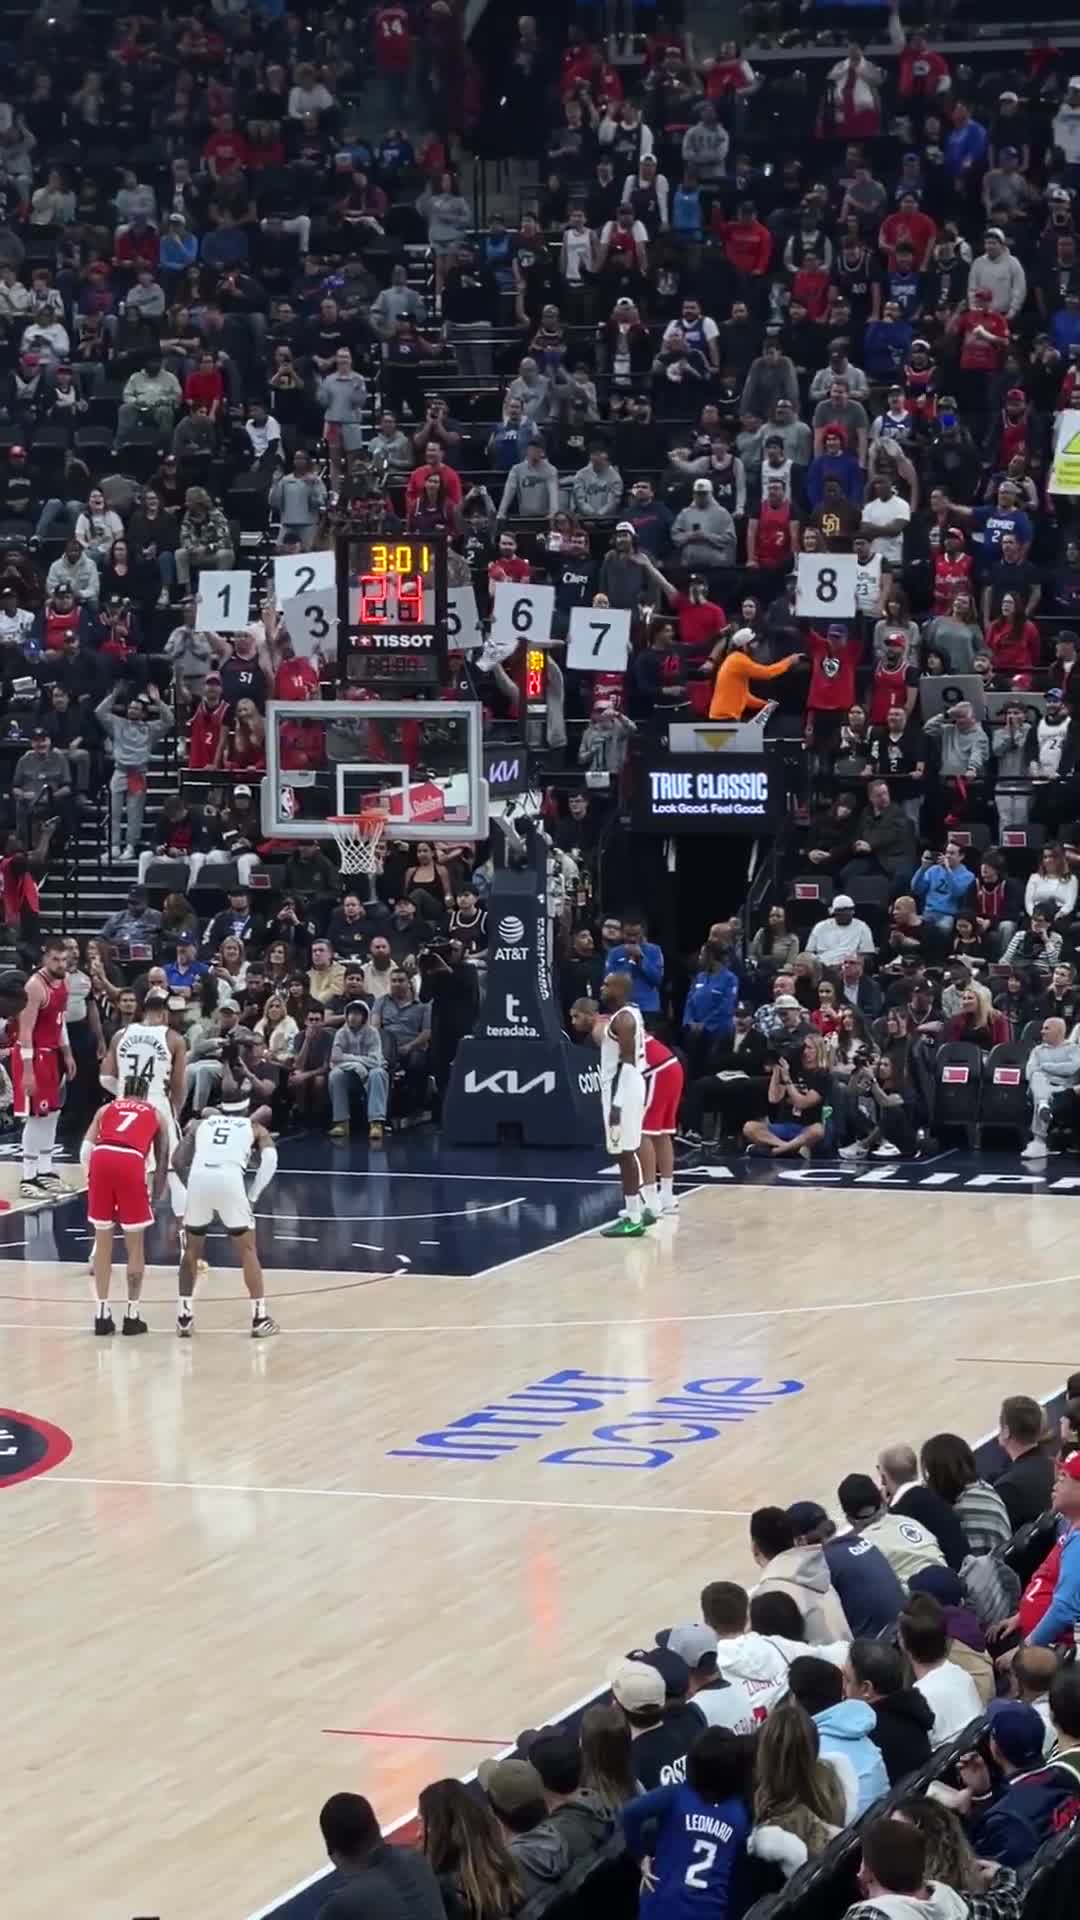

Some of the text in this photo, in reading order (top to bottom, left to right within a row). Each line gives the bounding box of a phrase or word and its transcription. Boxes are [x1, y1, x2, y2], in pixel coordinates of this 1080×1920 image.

[371, 546, 430, 573] 3:01
[295, 566, 316, 597] 2
[816, 567, 838, 603] 8
[217, 584, 232, 618] 1
[361, 575, 423, 623] 24
[304, 605, 330, 638] 3
[448, 602, 462, 636] 5
[511, 598, 534, 632] 6
[589, 622, 612, 656] 7
[649, 772, 768, 800] TRUE CLASSIC
[652, 803, 765, 814] Look Good. Feel Good.
[495, 947, 529, 960] AT&T
[486, 1025, 540, 1037] teradata.
[126, 1053, 155, 1082] 34
[115, 1111, 139, 1132] 7
[212, 1127, 231, 1145] 5
[383, 1368, 654, 1461] INTUIT
[685, 1813, 734, 1844] LEONARD
[684, 1838, 719, 1889] 2
